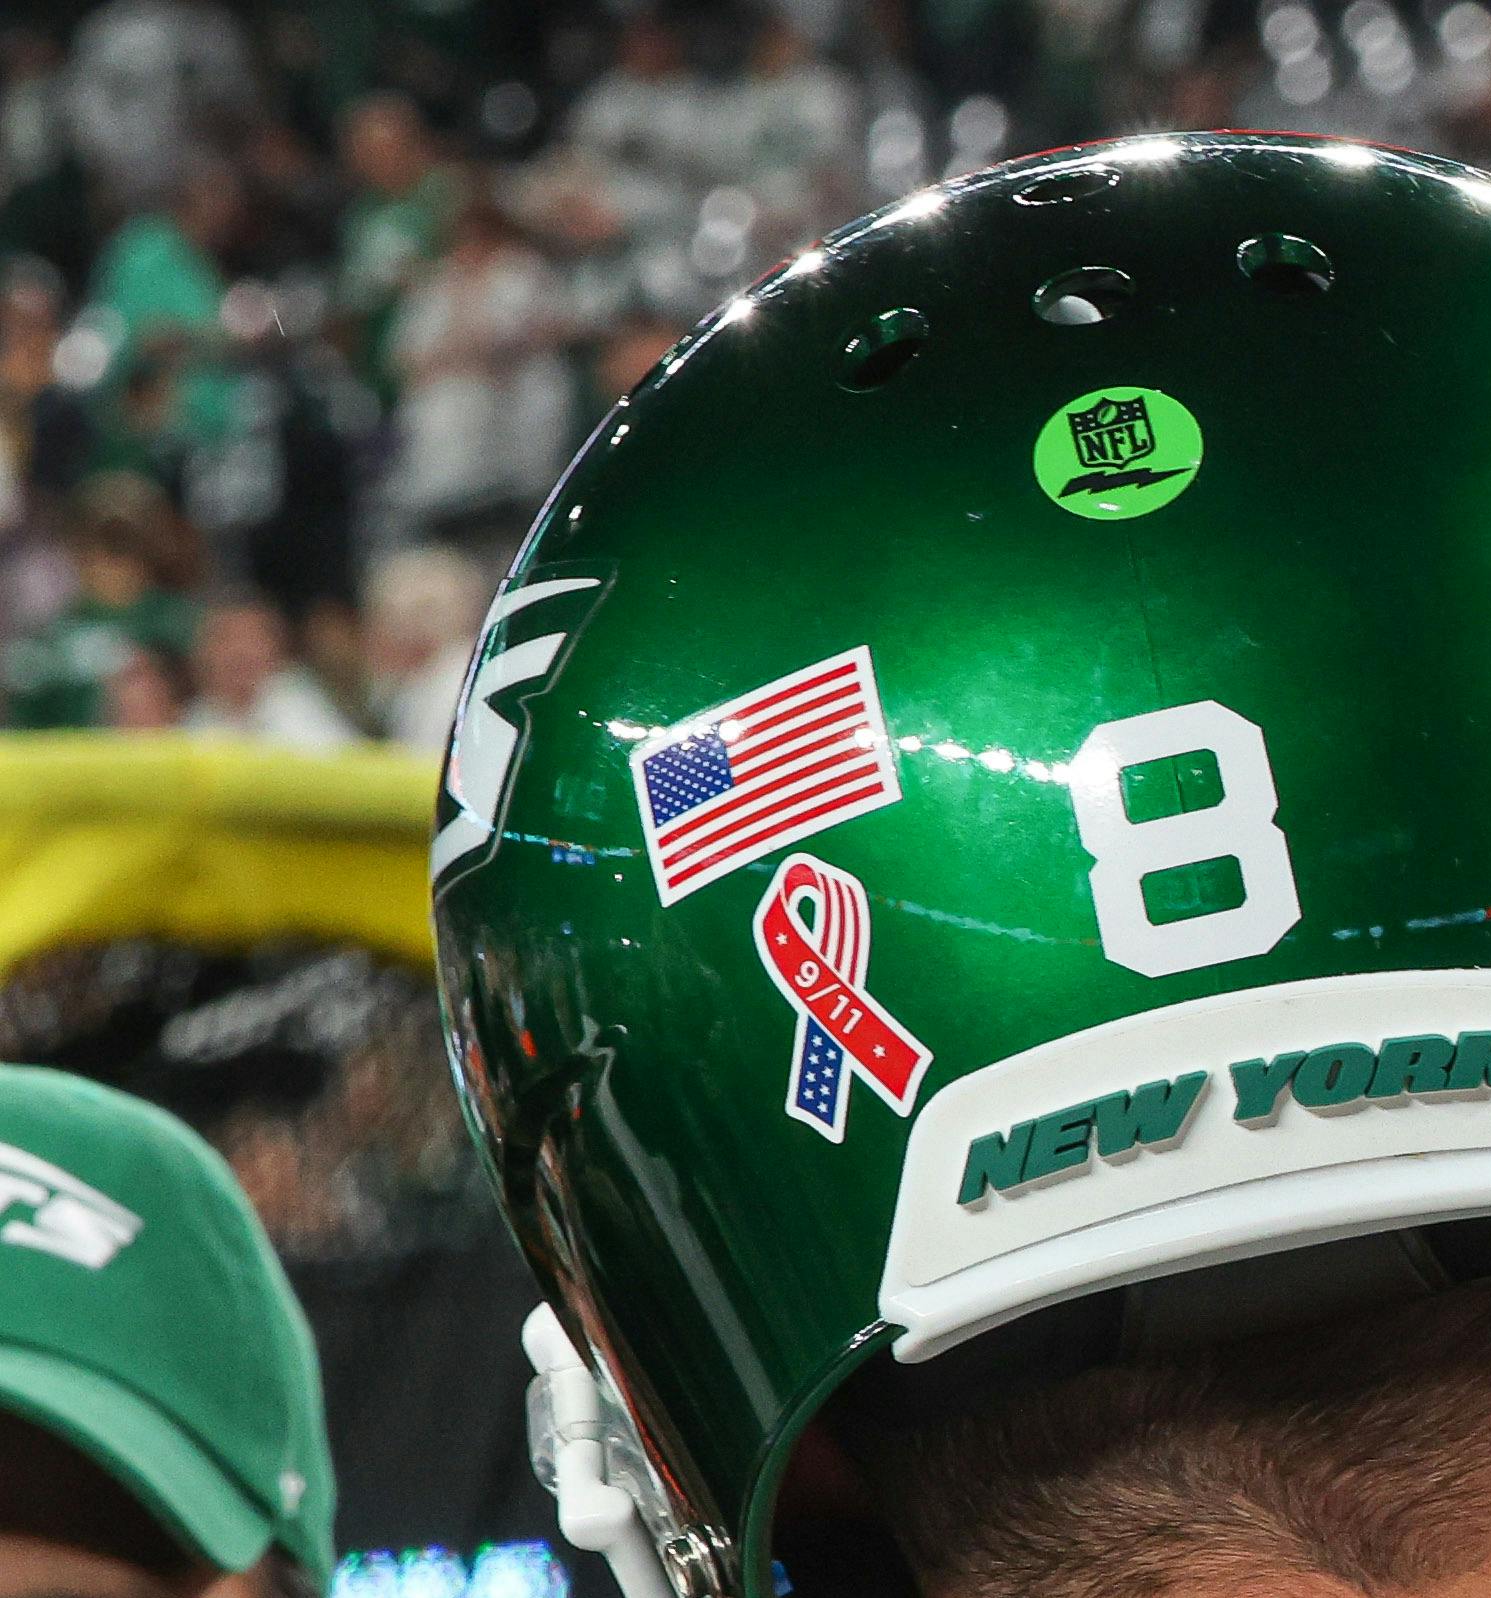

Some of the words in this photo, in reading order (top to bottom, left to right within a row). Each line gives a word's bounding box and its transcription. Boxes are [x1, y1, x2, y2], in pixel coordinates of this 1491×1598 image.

[1081, 423, 1150, 463] NFL
[1068, 698, 1302, 978] 8
[793, 958, 863, 1035] 9/11
[956, 1069, 1209, 1205] NEW
